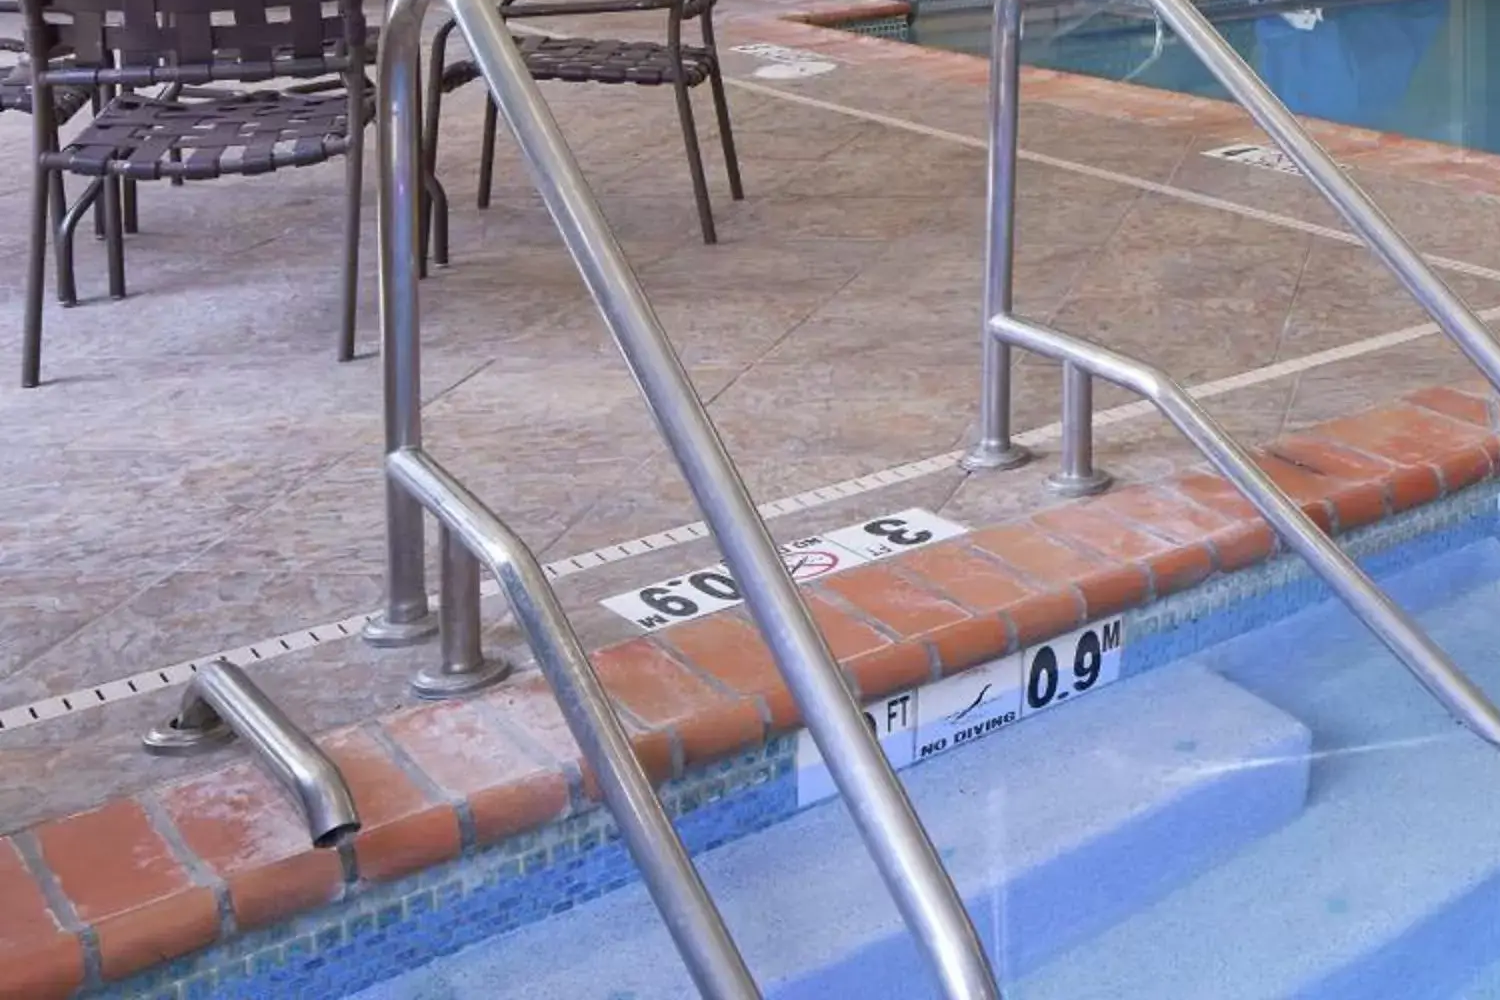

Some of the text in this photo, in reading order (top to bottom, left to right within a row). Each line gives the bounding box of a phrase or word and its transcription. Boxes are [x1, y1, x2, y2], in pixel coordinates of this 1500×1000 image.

[864, 518, 933, 546] 3
[1027, 630, 1101, 709] 0.9
[887, 695, 912, 733] FT
[921, 711, 1017, 757] NO DIVING
